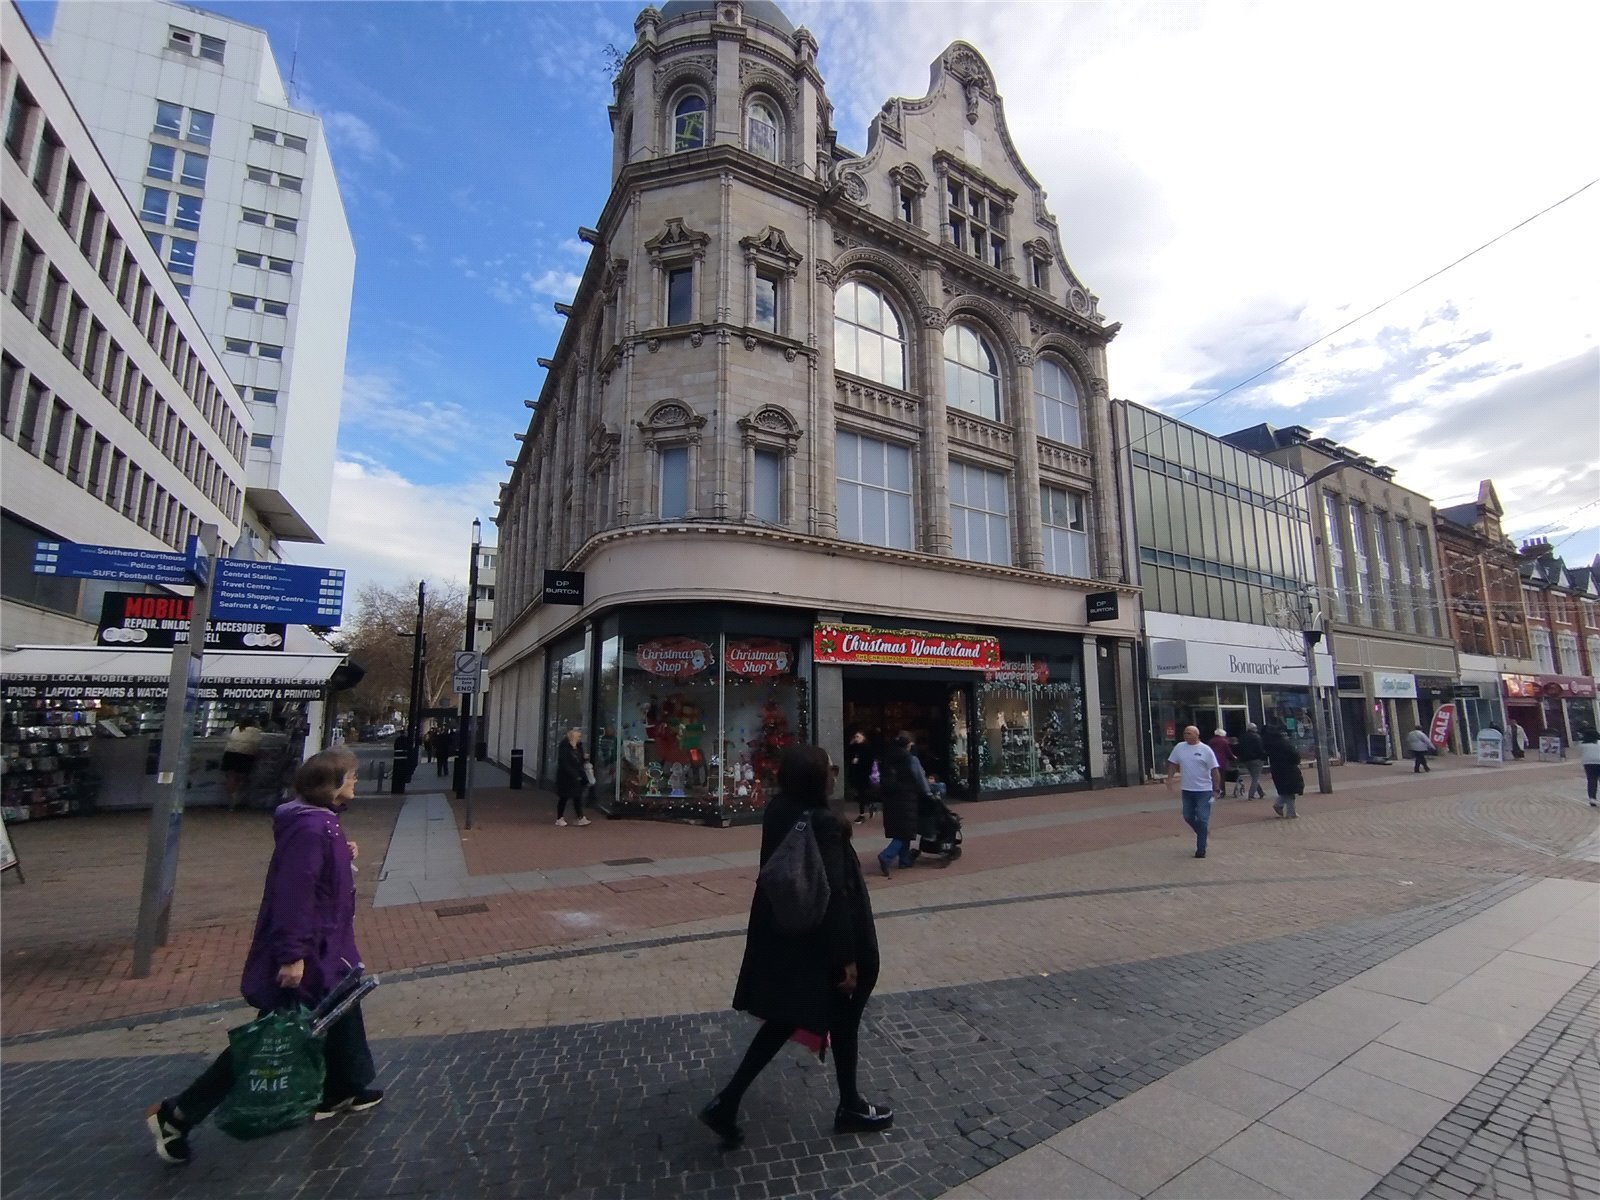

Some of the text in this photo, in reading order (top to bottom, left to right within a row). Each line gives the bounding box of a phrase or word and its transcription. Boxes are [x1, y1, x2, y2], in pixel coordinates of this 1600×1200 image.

[97, 548, 138, 557] Southend
[140, 551, 186, 561] Courthouse
[130, 561, 156, 569] Police
[224, 560, 249, 569] County
[92, 569, 117, 577] SUFC
[119, 571, 153, 580] Football
[155, 574, 185, 583] Ground
[222, 570, 251, 578] Central
[220, 590, 245, 599] Royals
[246, 593, 280, 602] Shopping
[545, 587, 580, 595] BURTON
[125, 597, 192, 619] MOBIL
[1090, 606, 1114, 614] BURTON
[124, 619, 159, 629] REPAIR.
[215, 624, 266, 634] ACCESORIES
[842, 634, 980, 659] Christmas Wonderland
[642, 649, 694, 661] Christmas
[730, 648, 778, 661] Christmas
[655, 661, 681, 674] Shop
[742, 661, 766, 673] Shop
[1228, 654, 1280, 676] Bonmarché
[52, 674, 88, 682] LOCAL
[92, 675, 133, 683] MOBILE
[237, 677, 272, 685] CENTER
[7, 687, 37, 698] IPADS
[45, 687, 83, 698] LAPTOP
[85, 687, 126, 698] REPAIRS
[127, 688, 134, 698] &
[137, 688, 168, 698] WATCH
[223, 689, 275, 699] PHOTOCOPY
[276, 690, 282, 699] &
[283, 689, 321, 700] PRINTING
[1434, 711, 1450, 742] SALE
